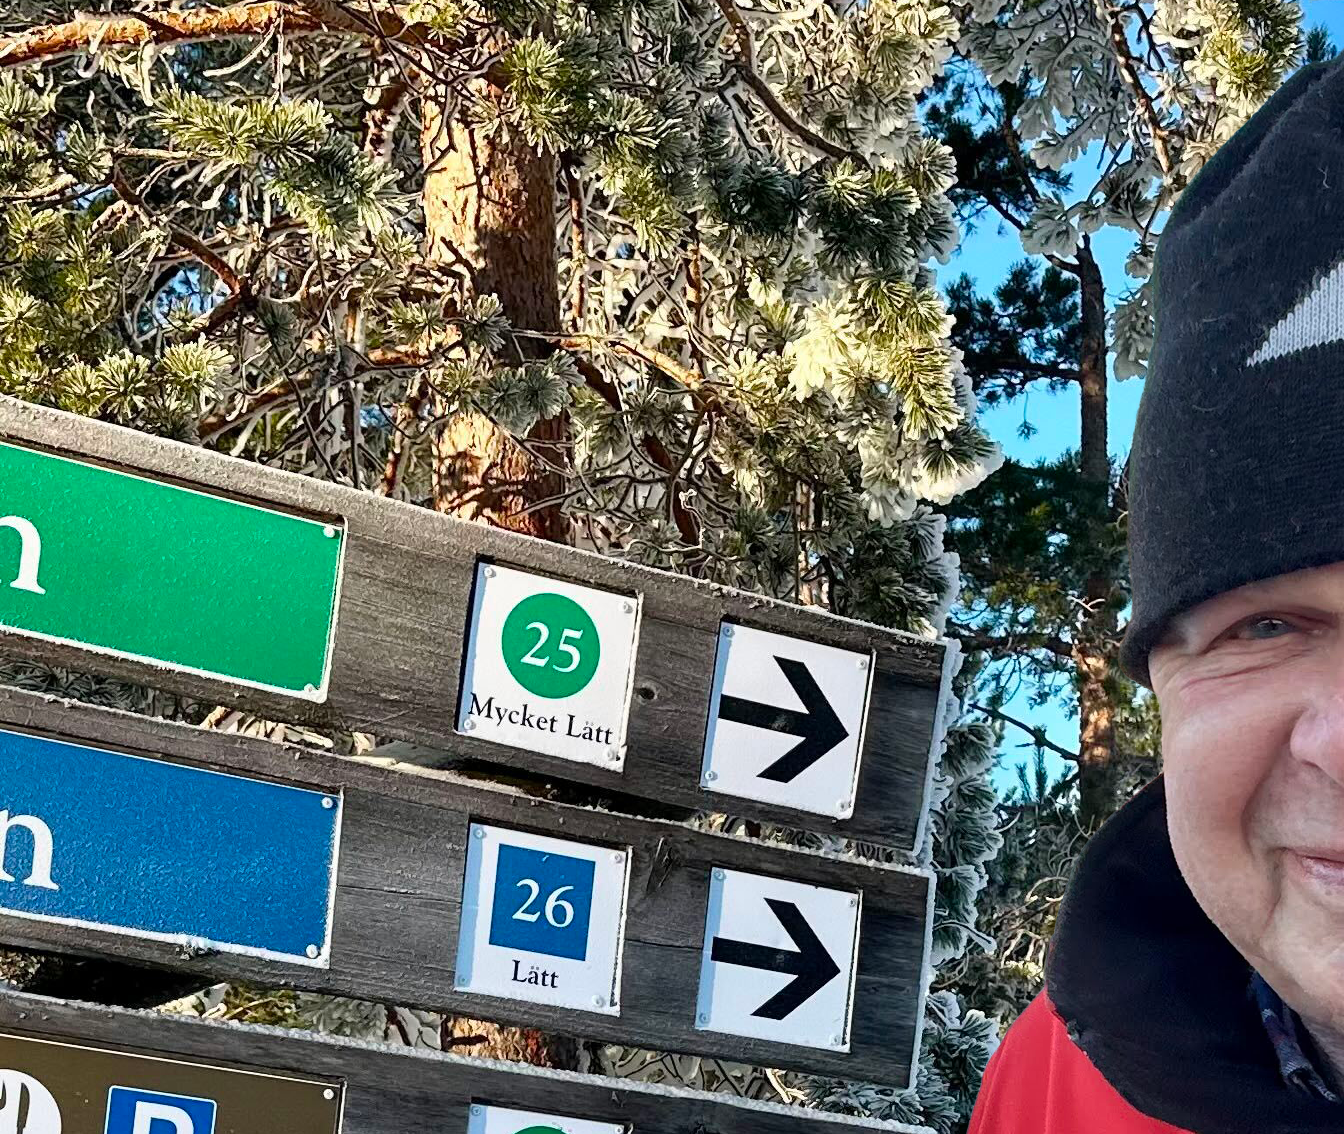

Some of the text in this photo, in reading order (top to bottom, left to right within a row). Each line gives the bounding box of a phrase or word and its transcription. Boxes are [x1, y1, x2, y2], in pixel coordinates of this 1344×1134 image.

[520, 621, 584, 673] 25
[467, 692, 613, 745] Mycket Lätt
[511, 878, 575, 928] 26
[511, 958, 559, 988] Lätt
